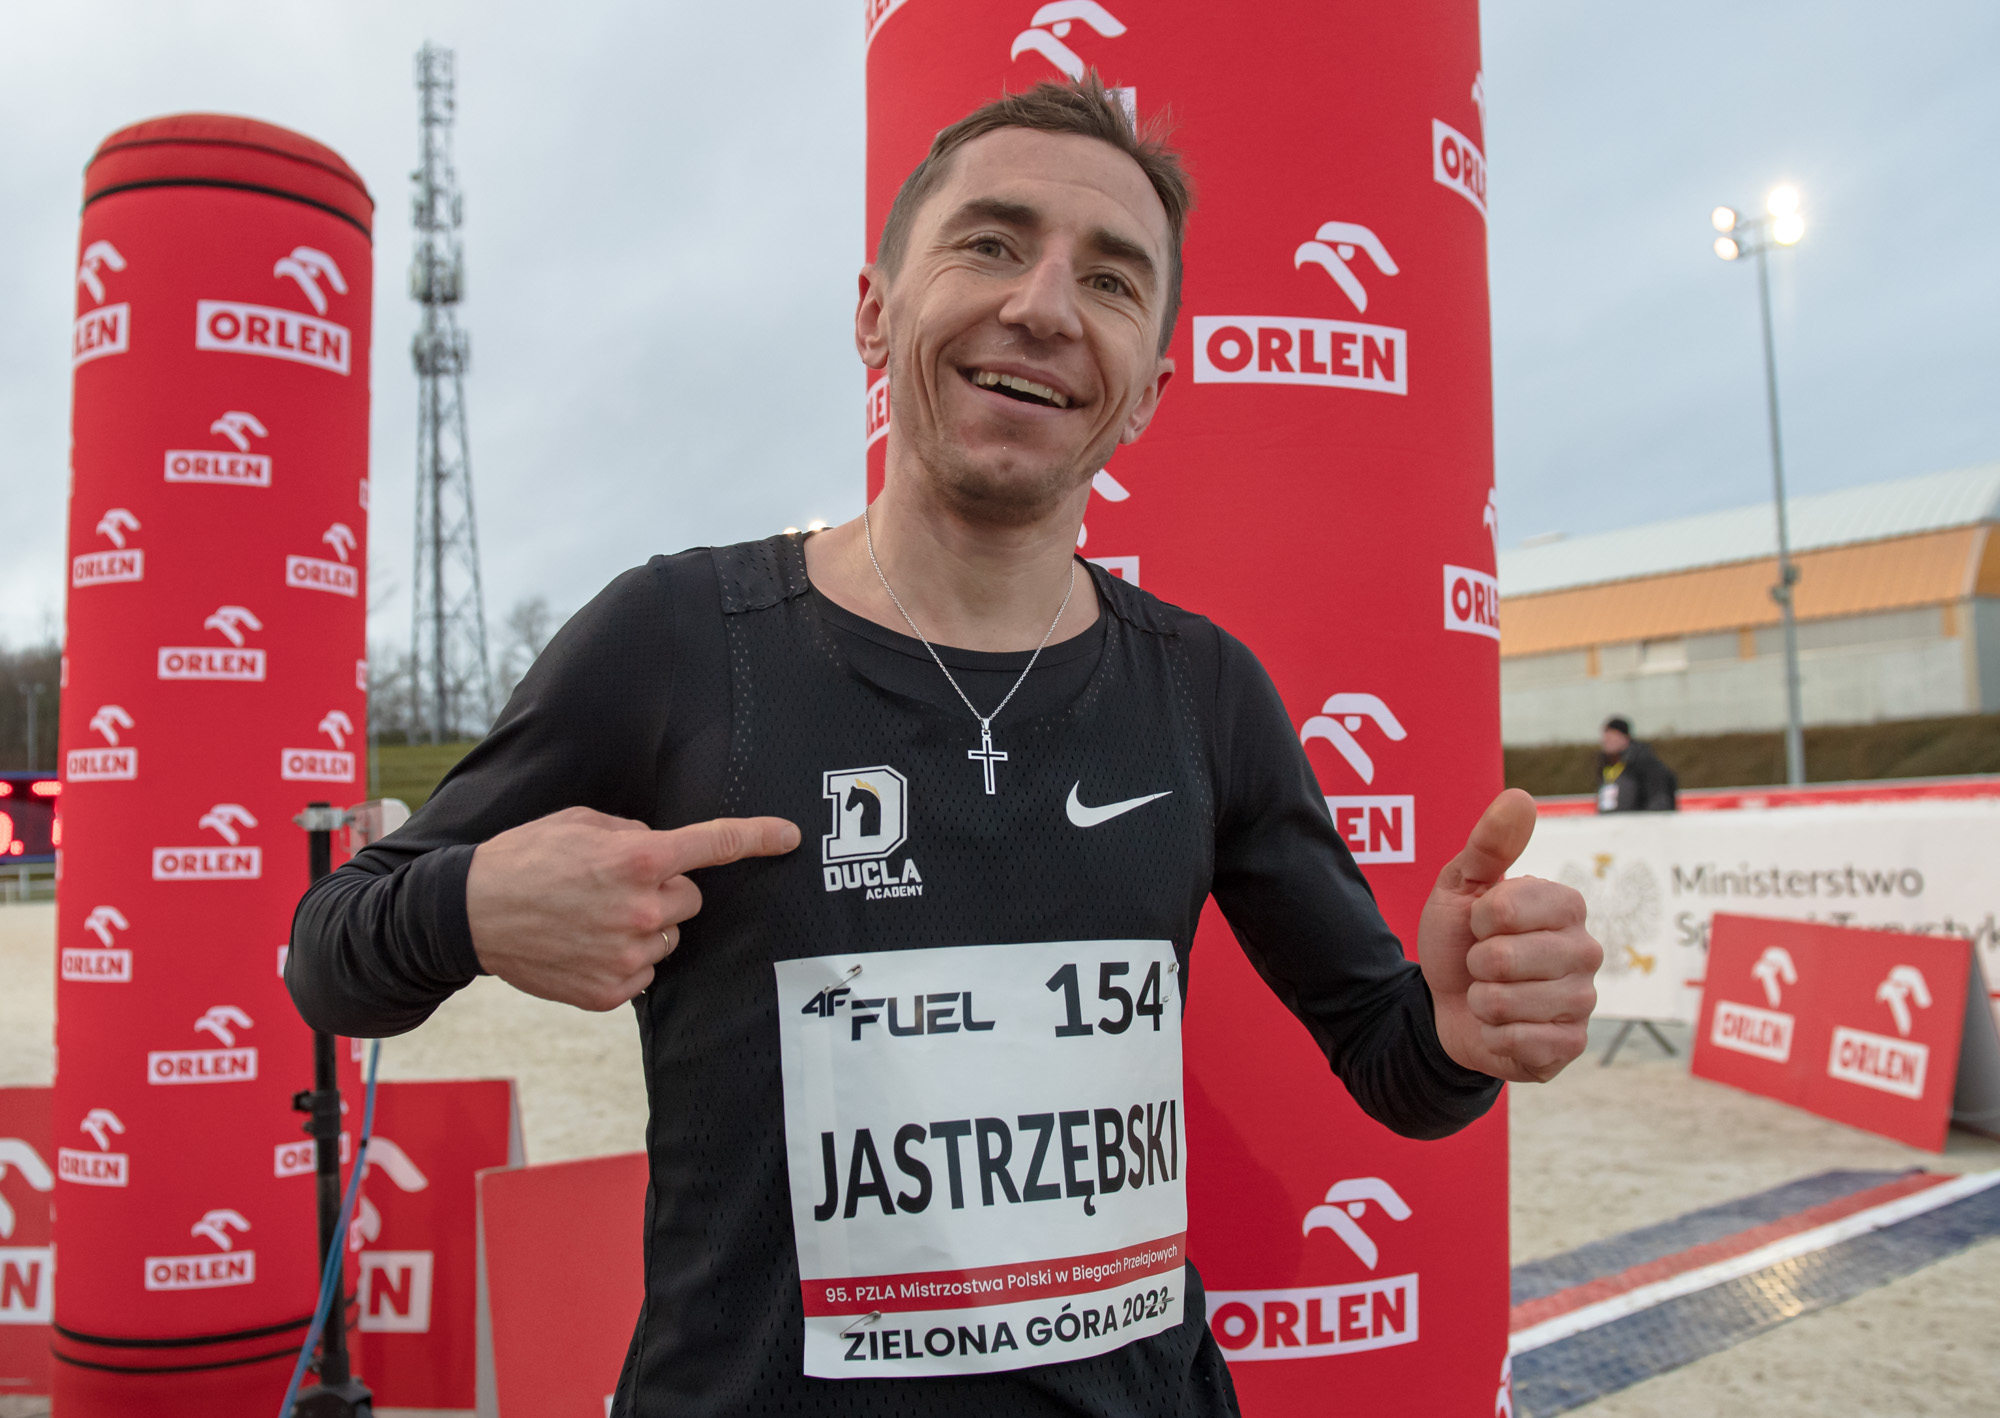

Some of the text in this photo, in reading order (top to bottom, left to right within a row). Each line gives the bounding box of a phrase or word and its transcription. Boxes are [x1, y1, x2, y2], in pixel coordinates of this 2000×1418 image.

[208, 309, 342, 362] ORLEN
[1206, 326, 1395, 381] ORLEN
[171, 456, 263, 479] ORLEN
[75, 555, 135, 579] ORLEN
[292, 563, 353, 590] ORLEN
[164, 654, 258, 674] ORLEN
[69, 754, 129, 774] ORLEN
[288, 756, 350, 775] ORLEN
[159, 853, 253, 872] ORLEN
[823, 859, 922, 892] DUCLA
[1671, 862, 1924, 897] Ministerstwo
[866, 885, 923, 900] ACADEMY
[63, 956, 124, 975] ORLEN
[1045, 961, 1163, 1037] 154
[851, 991, 996, 1041] FUEL
[155, 1055, 248, 1077] ORLEN
[60, 1156, 121, 1180] ORLEN
[814, 1100, 1177, 1222] JASTRZĘBSKI
[152, 1258, 246, 1282] ORLEN
[825, 1244, 1178, 1303] 95. PZLA Mistrzostwa Polski w Biegach Przełajowych
[844, 1286, 1169, 1361] ZIELONA GÓRA 2023
[1211, 1287, 1406, 1350] ORLEN
